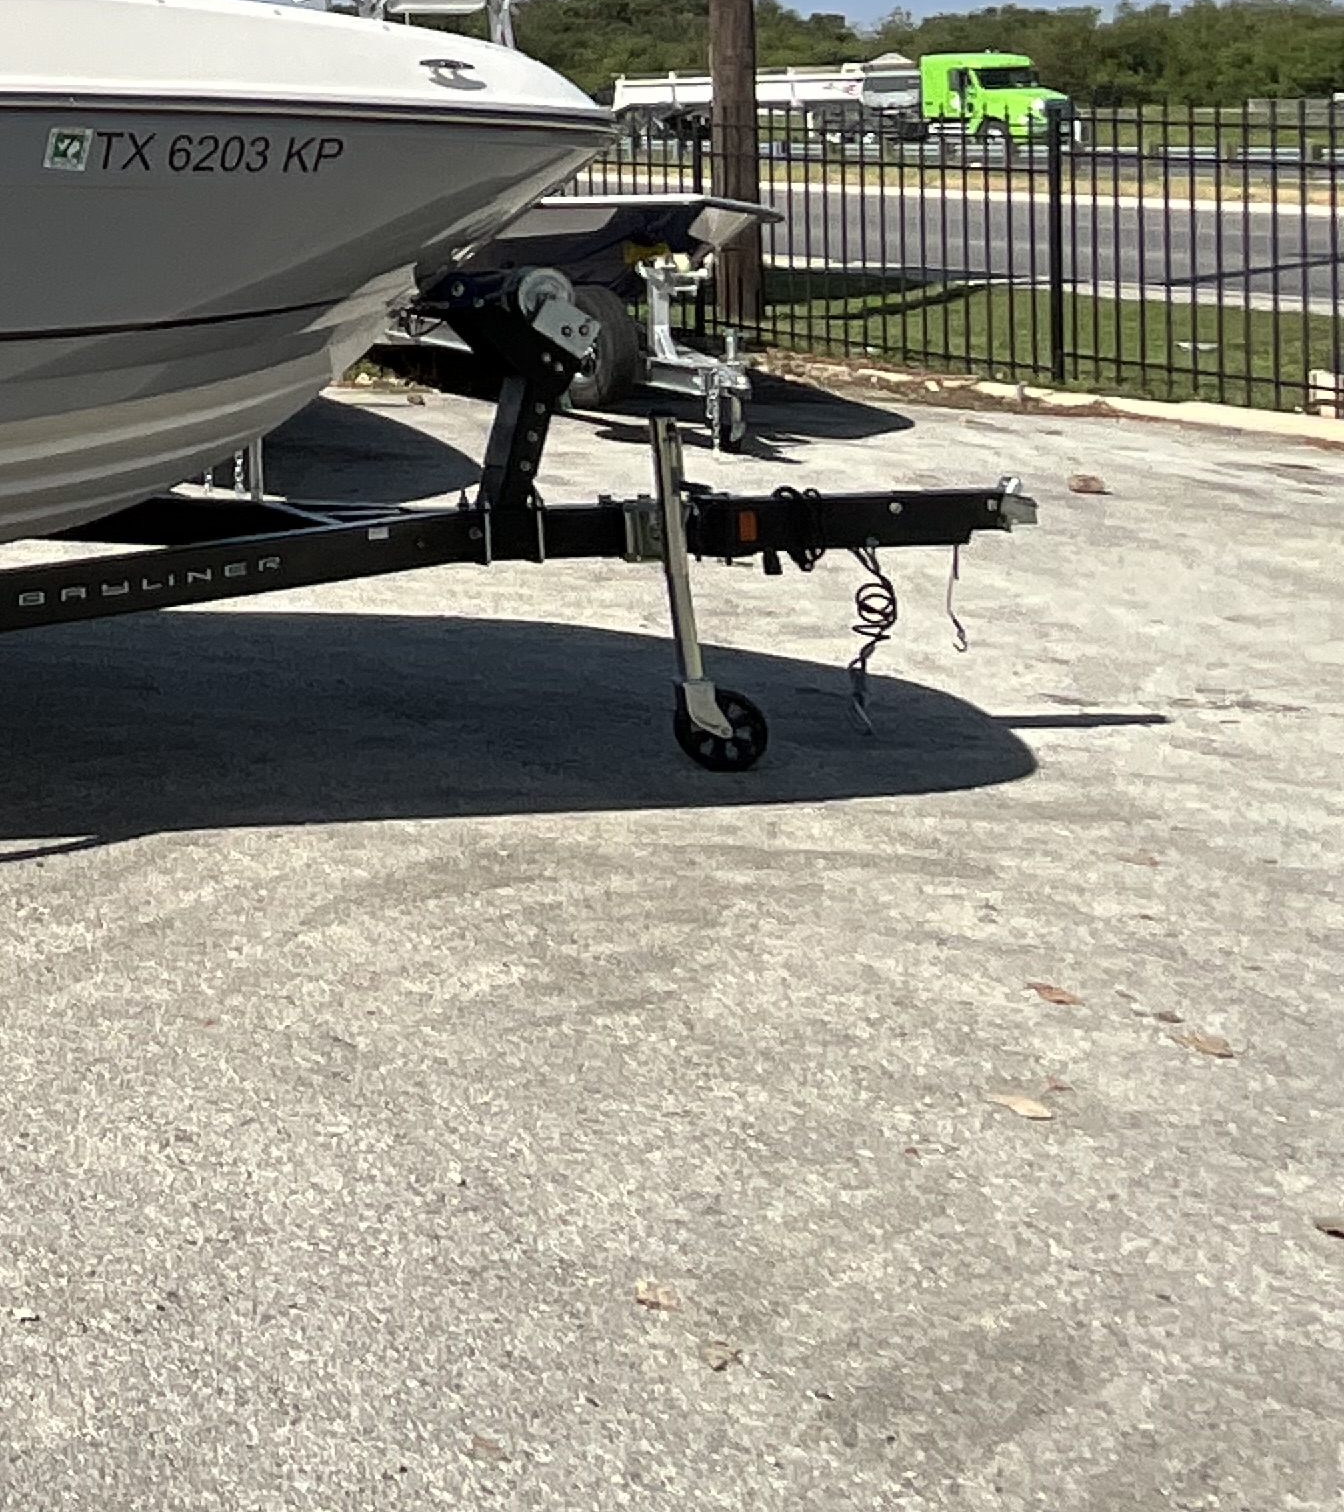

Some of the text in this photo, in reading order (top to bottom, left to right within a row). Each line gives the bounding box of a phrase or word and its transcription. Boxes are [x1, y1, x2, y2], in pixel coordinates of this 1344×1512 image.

[96, 131, 158, 172] TX
[167, 133, 271, 173] 6203
[281, 136, 345, 174] KP
[18, 555, 282, 607] BAYLINER
